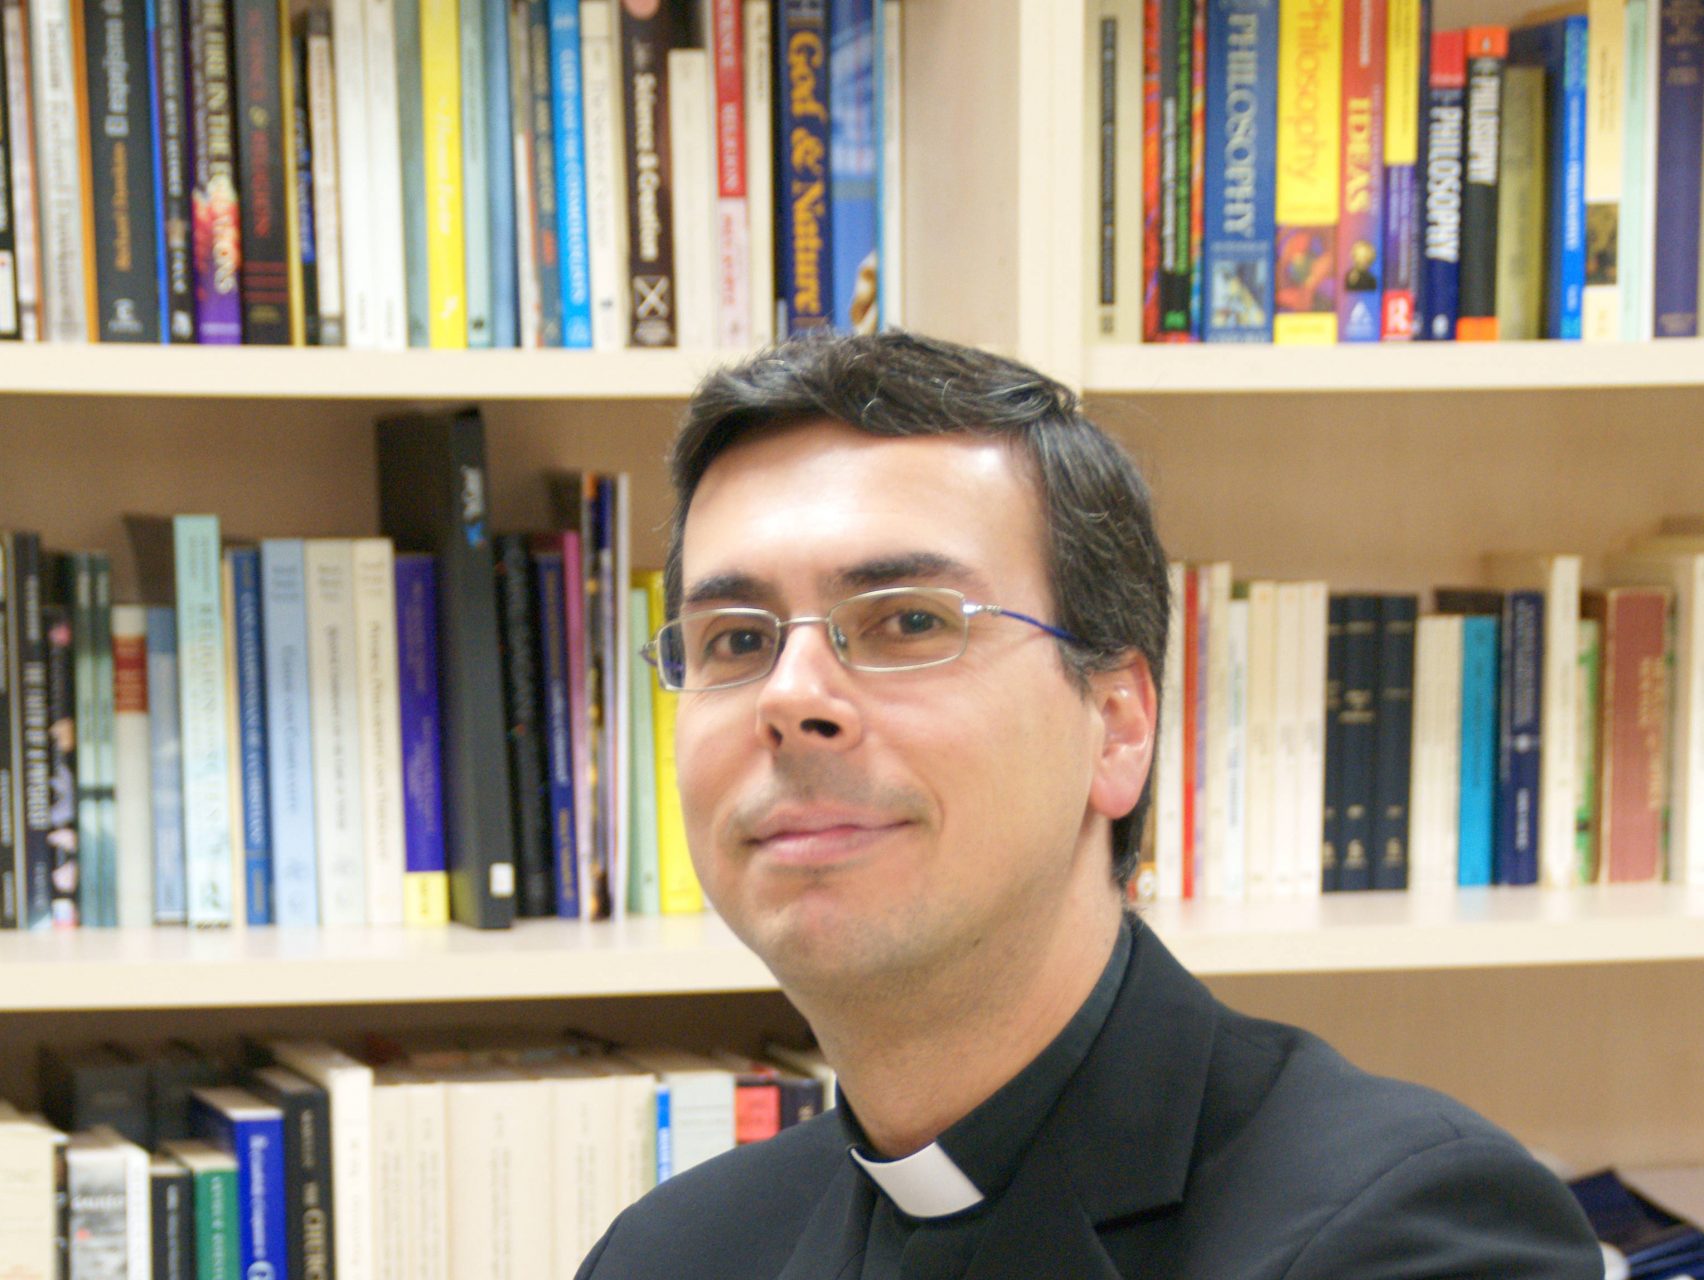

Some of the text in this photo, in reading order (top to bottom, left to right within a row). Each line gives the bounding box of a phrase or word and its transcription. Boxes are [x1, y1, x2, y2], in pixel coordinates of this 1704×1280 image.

[205, 32, 229, 77] FIRE
[207, 81, 230, 110] IN
[719, 0, 741, 191] CIENCE RELIGION
[208, 114, 230, 158] THE
[634, 73, 658, 150] Science
[1223, 13, 1258, 239] PHILOSOPHY
[1345, 97, 1371, 214] IDEAS
[1468, 76, 1501, 185] PHILOSOPHY
[251, 131, 272, 238] RELIGION
[637, 173, 662, 260] Creation
[788, 32, 828, 314] God & Nature
[1427, 106, 1463, 262] PHILOSOPHY
